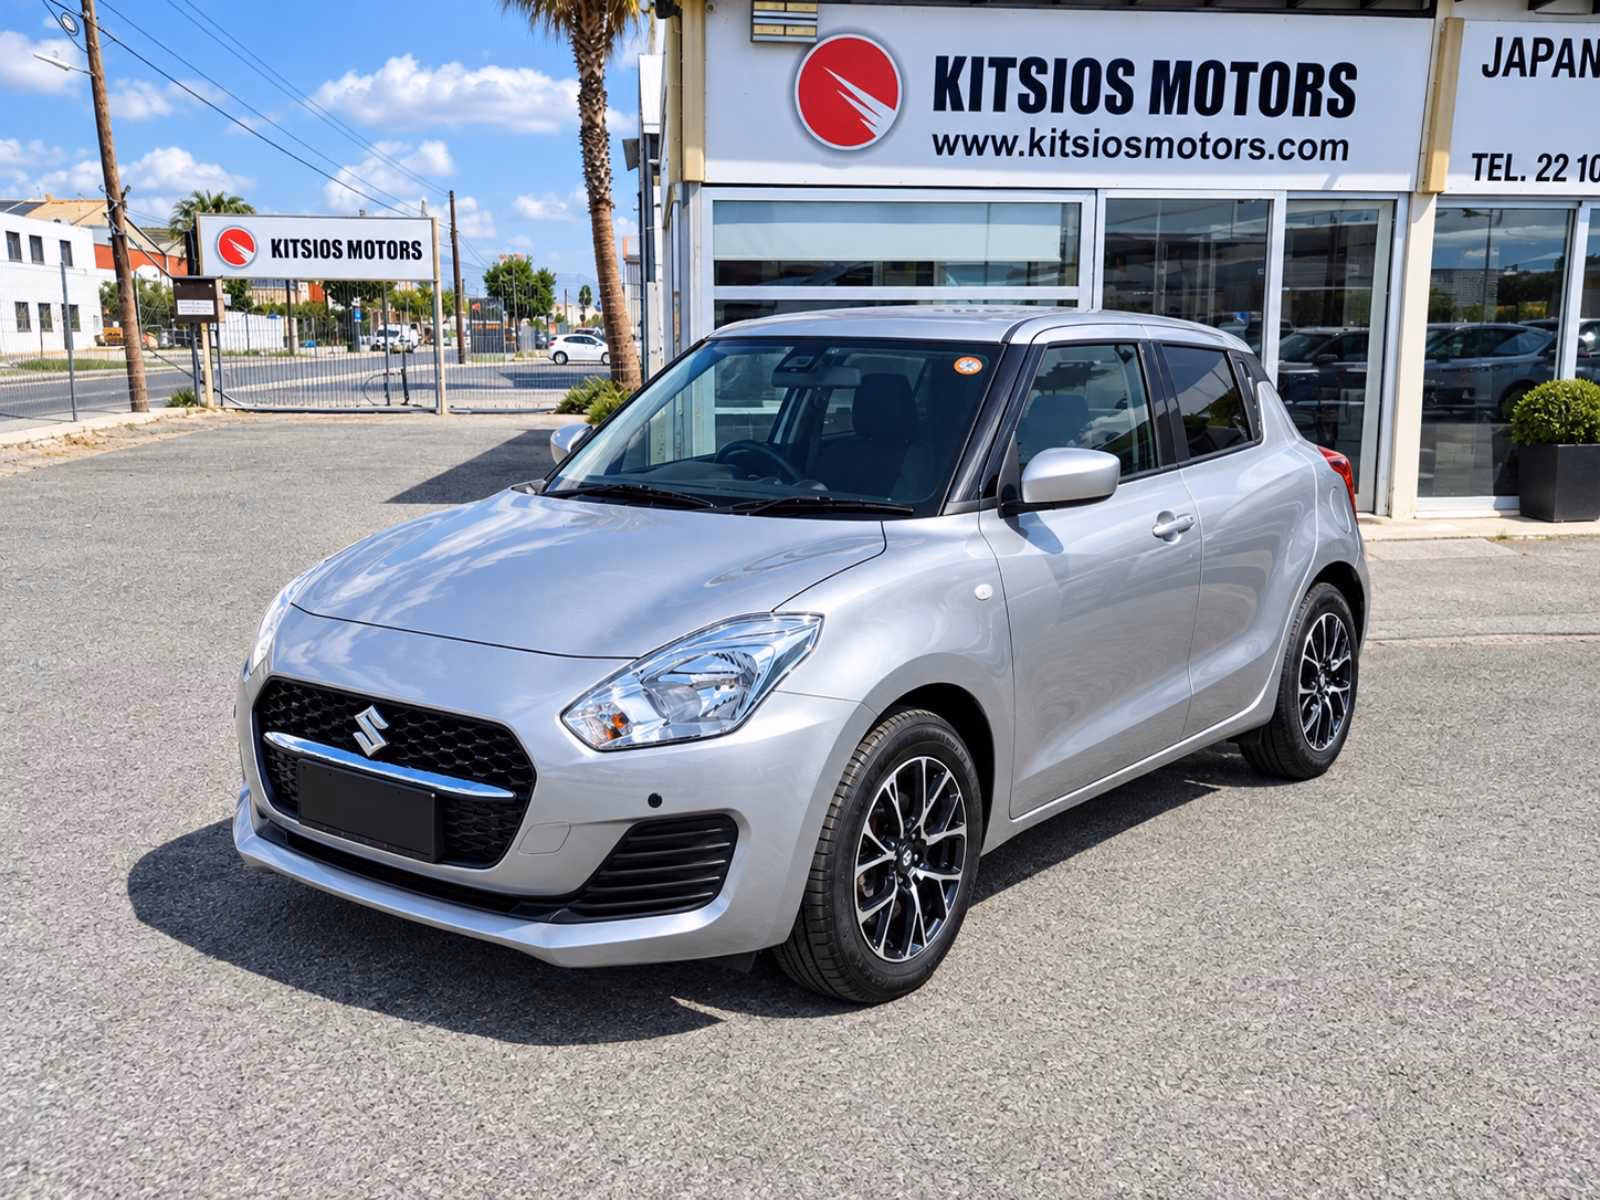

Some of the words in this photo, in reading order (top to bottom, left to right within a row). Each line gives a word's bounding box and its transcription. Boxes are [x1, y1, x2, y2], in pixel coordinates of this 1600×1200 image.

[1481, 36, 1600, 78] JAPAN
[932, 55, 1136, 116] KITSIOS
[1148, 59, 1358, 119] MOTORS
[931, 126, 1349, 161] www.kitsiosmotors.com
[1471, 152, 1527, 182] TEL.
[1535, 152, 1570, 182] 22
[270, 238, 343, 260] KITSIOS
[346, 239, 423, 261] MOTORS
